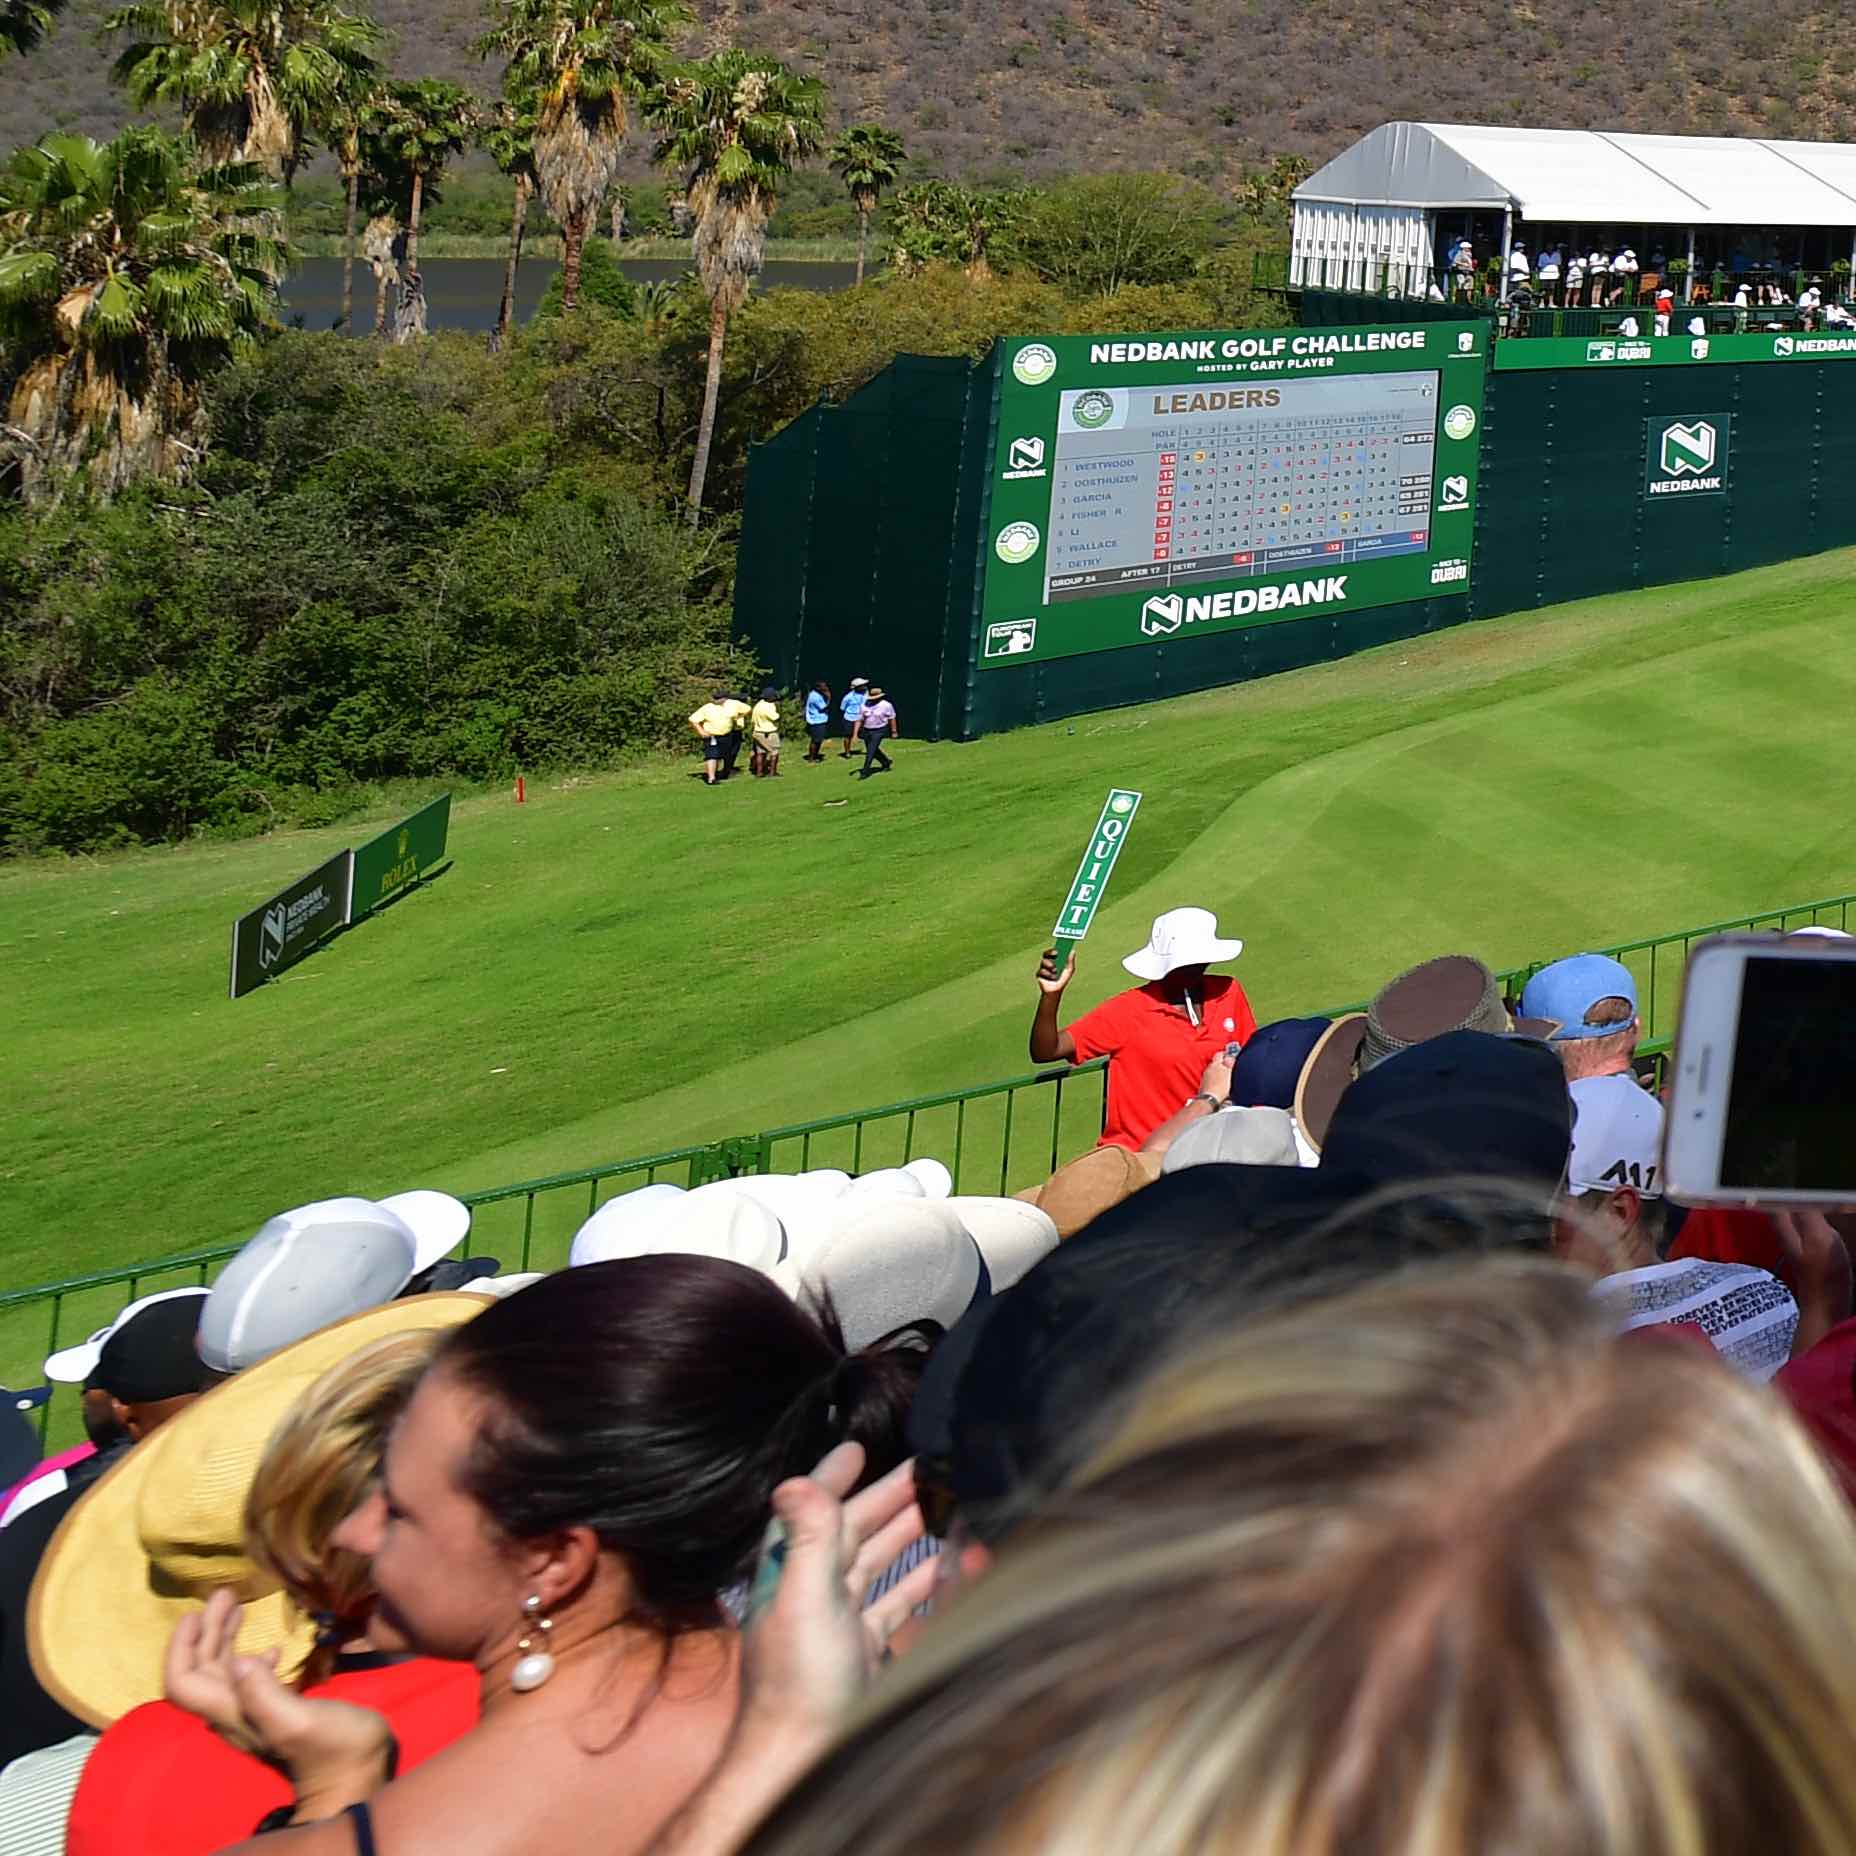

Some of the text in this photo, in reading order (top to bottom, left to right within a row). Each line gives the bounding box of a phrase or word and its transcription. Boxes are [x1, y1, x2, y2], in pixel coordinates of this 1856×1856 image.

[1090, 331, 1426, 364] NEDBANK GOLF CHALLENGE
[1249, 359, 1285, 372] GARY
[1287, 356, 1335, 369] PLAYER
[1153, 387, 1281, 416] LEADERS
[1650, 476, 1721, 494] NEDBANK
[1073, 493, 1112, 504] GARCIA
[1051, 576, 1083, 588] GROUP
[1120, 566, 1161, 579] AFTER 17
[1431, 564, 1467, 584] DUBAI
[1185, 575, 1348, 623] NEDBANK
[382, 855, 417, 893] ROLEX
[1069, 819, 1123, 924] QUIET
